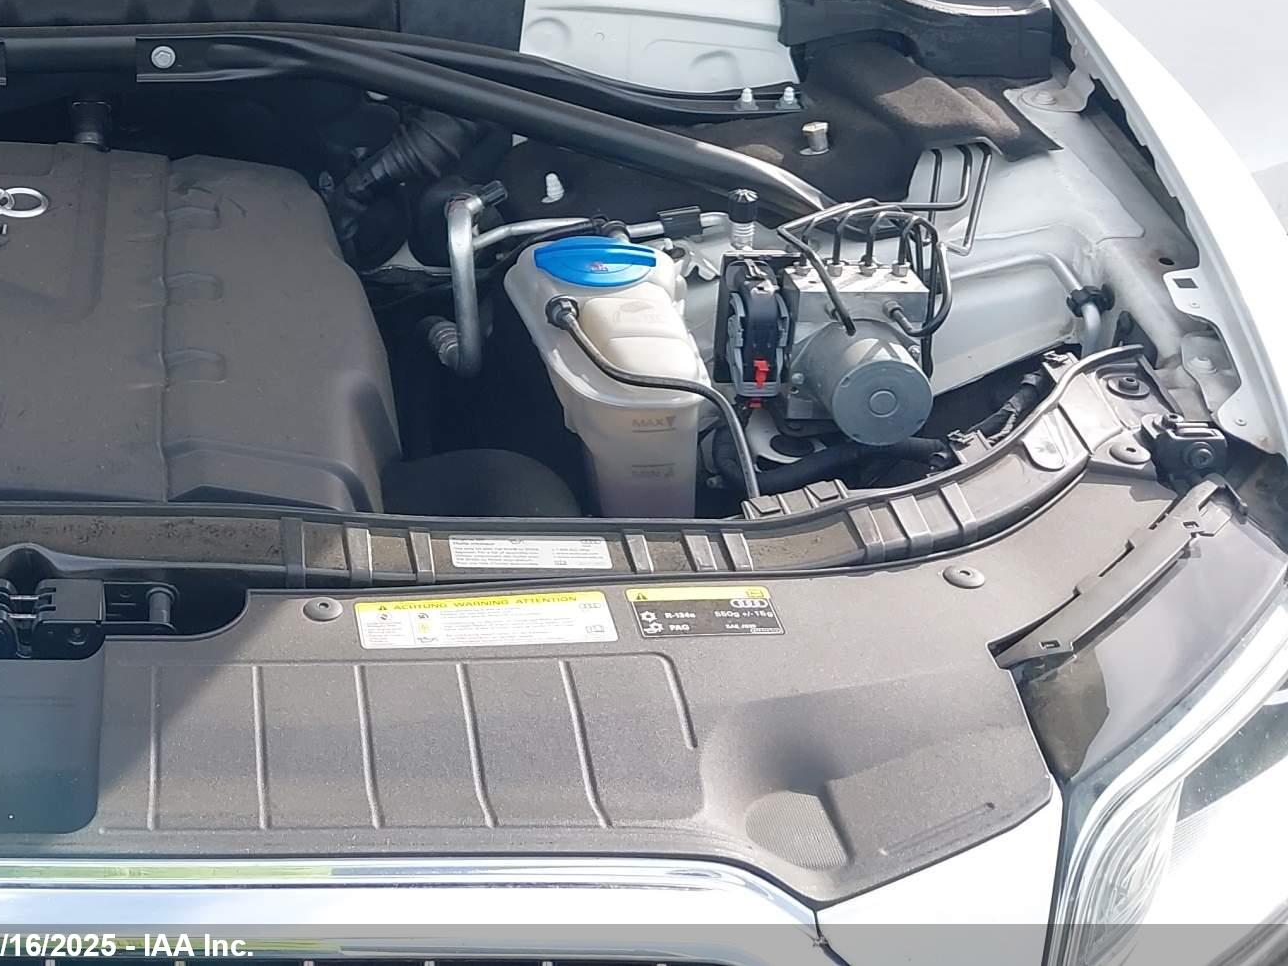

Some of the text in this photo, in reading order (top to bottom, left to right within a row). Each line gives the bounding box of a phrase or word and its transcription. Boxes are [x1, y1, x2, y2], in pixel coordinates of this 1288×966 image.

[632, 418, 665, 426] MAX
[393, 596, 578, 611] ACHTUNG WARNING ATTENTION
